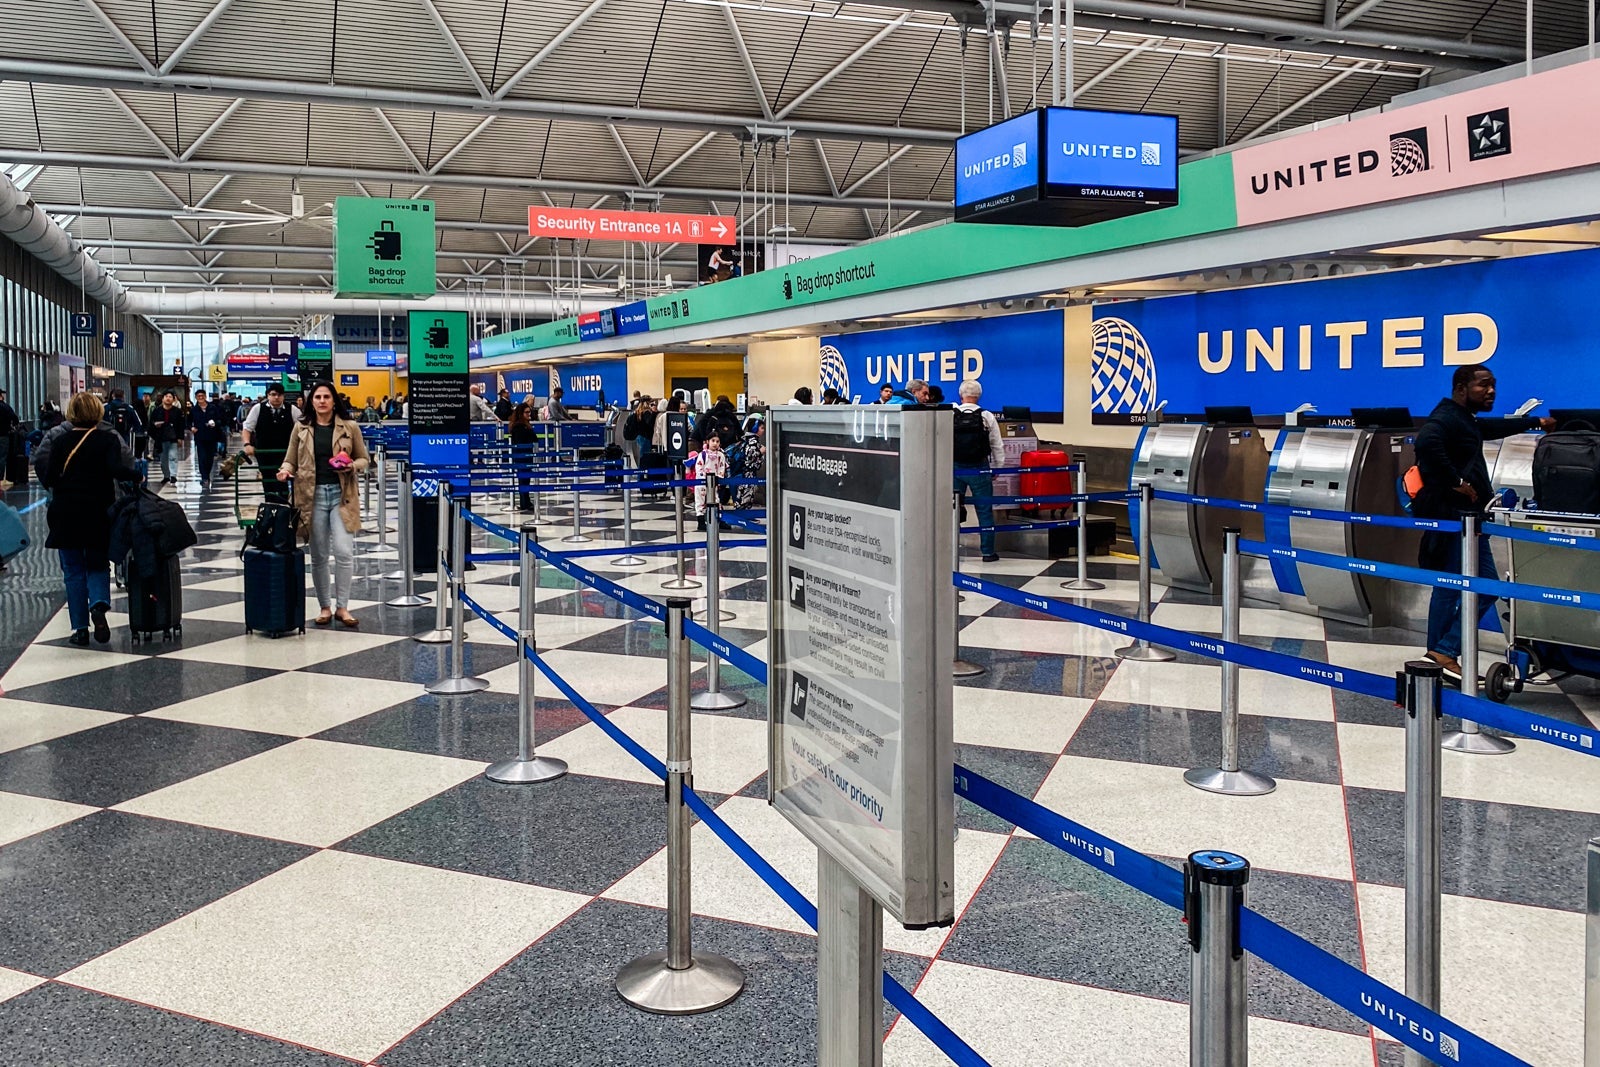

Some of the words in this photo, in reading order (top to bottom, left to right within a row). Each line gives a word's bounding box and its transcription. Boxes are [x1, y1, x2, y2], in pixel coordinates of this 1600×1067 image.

[1062, 142, 1137, 159] UNITED
[964, 154, 1010, 178] UNITED
[1251, 149, 1379, 194] UNITED
[1100, 189, 1136, 198] ALLIANCE
[974, 203, 987, 211] STAR
[987, 196, 1010, 208] ALLIANCE
[537, 215, 596, 232] Security
[600, 218, 660, 234] Entrance
[664, 222, 682, 234] 1A
[368, 267, 385, 276] Bag
[386, 268, 406, 276] drop
[797, 276, 813, 294] Bag
[815, 272, 833, 290] drop
[835, 261, 875, 284] shortcut
[650, 307, 671, 319] UNITED
[337, 328, 404, 337] UNITED
[1198, 312, 1499, 374] UNITED
[866, 349, 983, 384] UNITED
[512, 380, 533, 393] UNITED
[571, 375, 602, 391] UNITED
[1328, 419, 1356, 427] IANCE
[788, 453, 815, 470] Checked
[817, 456, 847, 476] Baggage
[815, 511, 824, 520] your
[824, 512, 834, 523] bags
[834, 514, 851, 525] locked?
[807, 521, 812, 530] Be
[813, 523, 821, 532] sure
[814, 536, 824, 546] more
[851, 547, 861, 556] visit
[822, 578, 838, 592] carrying
[842, 584, 861, 599] firearm?
[806, 585, 823, 598] Firearms
[823, 592, 832, 603] may
[833, 595, 842, 607] only
[843, 599, 848, 608] be
[849, 601, 876, 619] transported
[1025, 598, 1042, 606] UNITED
[848, 616, 859, 627] must
[1100, 618, 1120, 627] UNITED
[713, 641, 725, 652] UNITED
[1190, 640, 1215, 651] UNITED
[1301, 666, 1333, 678] UNITED
[825, 690, 842, 708] carrying
[842, 699, 854, 712] film?
[1530, 724, 1577, 742] UNITED
[791, 736, 806, 758] Your
[807, 751, 828, 778] safety
[828, 764, 835, 782] is
[835, 774, 849, 793] our
[850, 784, 883, 822] priority
[1062, 831, 1102, 857] UNITED
[1361, 992, 1434, 1042] UNITED
